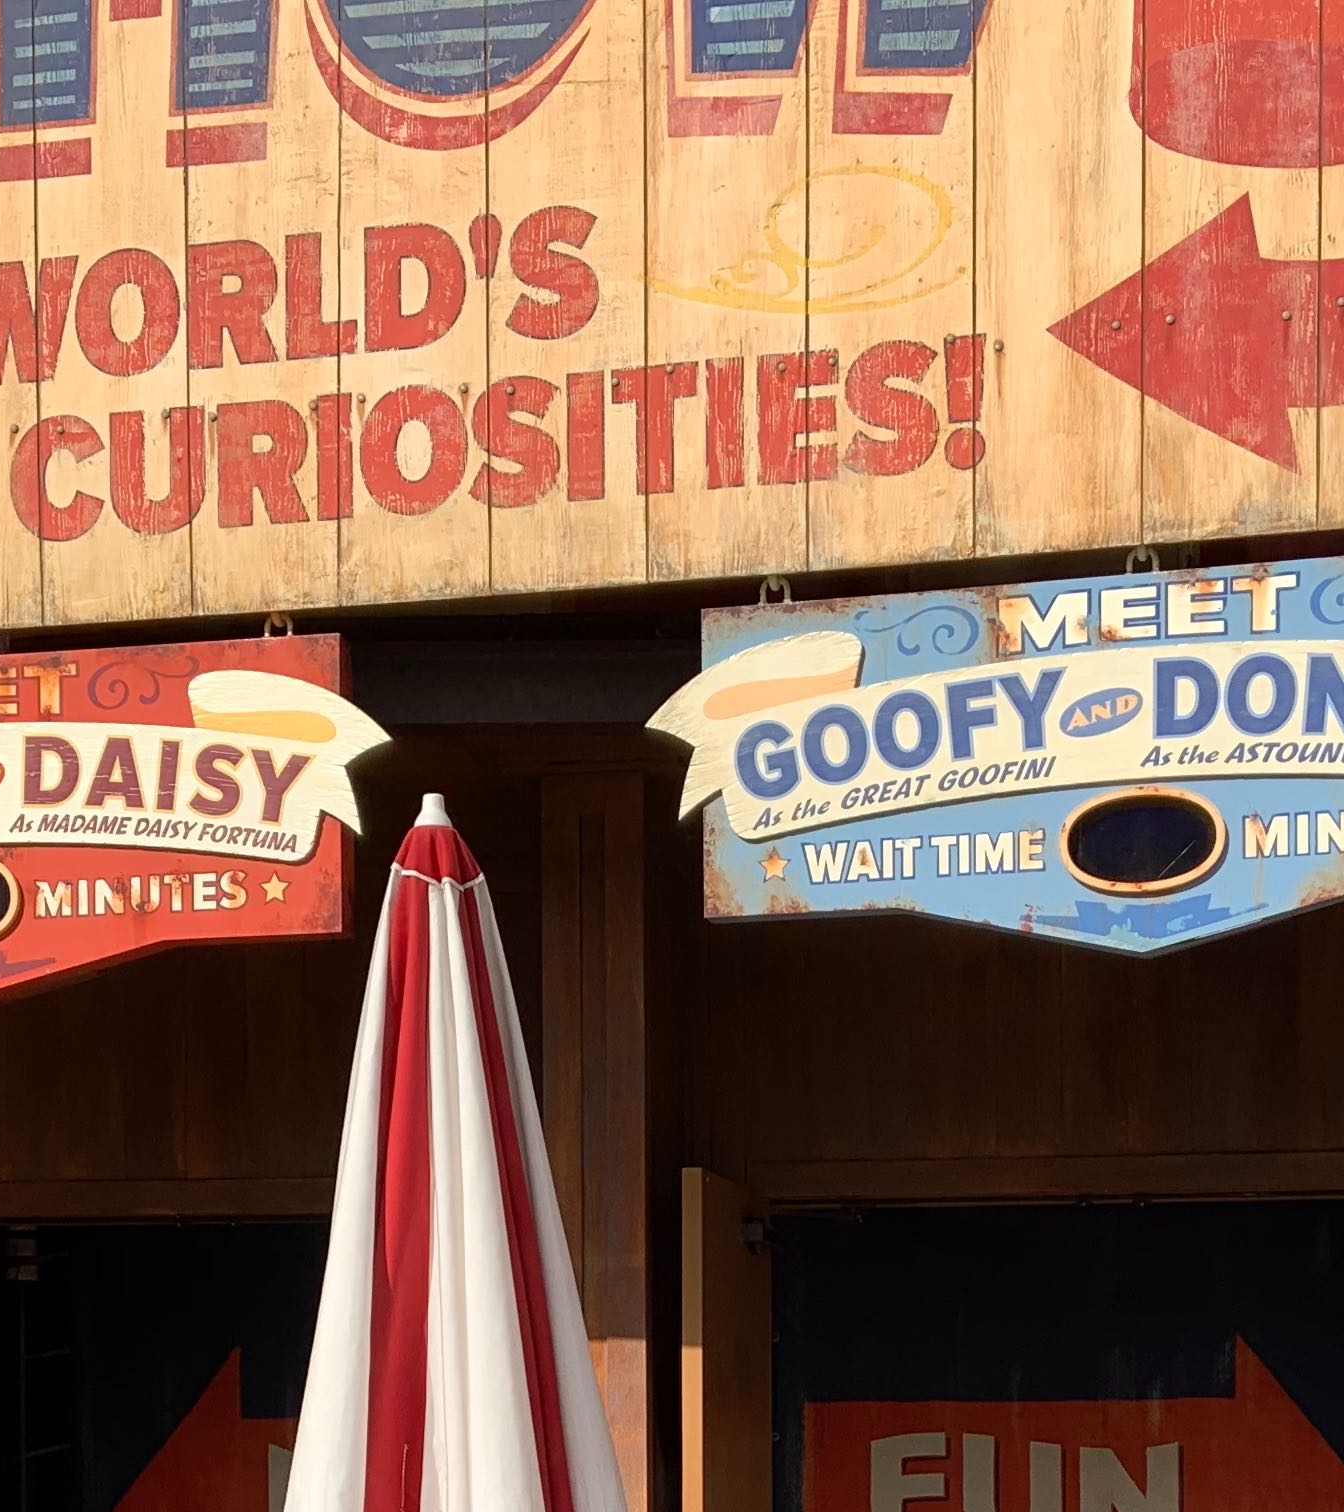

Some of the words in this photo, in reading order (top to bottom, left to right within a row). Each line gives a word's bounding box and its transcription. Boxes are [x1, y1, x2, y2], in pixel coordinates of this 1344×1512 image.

[9, 332, 988, 542] CURIOSITIES!
[996, 571, 1300, 658] MEET
[732, 664, 1068, 800] GOOFY
[1065, 692, 1140, 733] AND
[1141, 745, 1173, 768] As
[1178, 742, 1220, 767] the
[20, 733, 318, 824] DAISY
[752, 808, 785, 831] As
[791, 798, 831, 824] the
[841, 775, 932, 812] GREAT
[938, 755, 1056, 795] GOOFINI
[9, 814, 34, 833] As
[37, 814, 132, 836] MADAME
[134, 817, 198, 842] DAISY
[199, 821, 299, 854] FORTUNA
[801, 836, 920, 885] WAIT
[932, 828, 1047, 875] TIME
[32, 870, 250, 920] MINUTES
